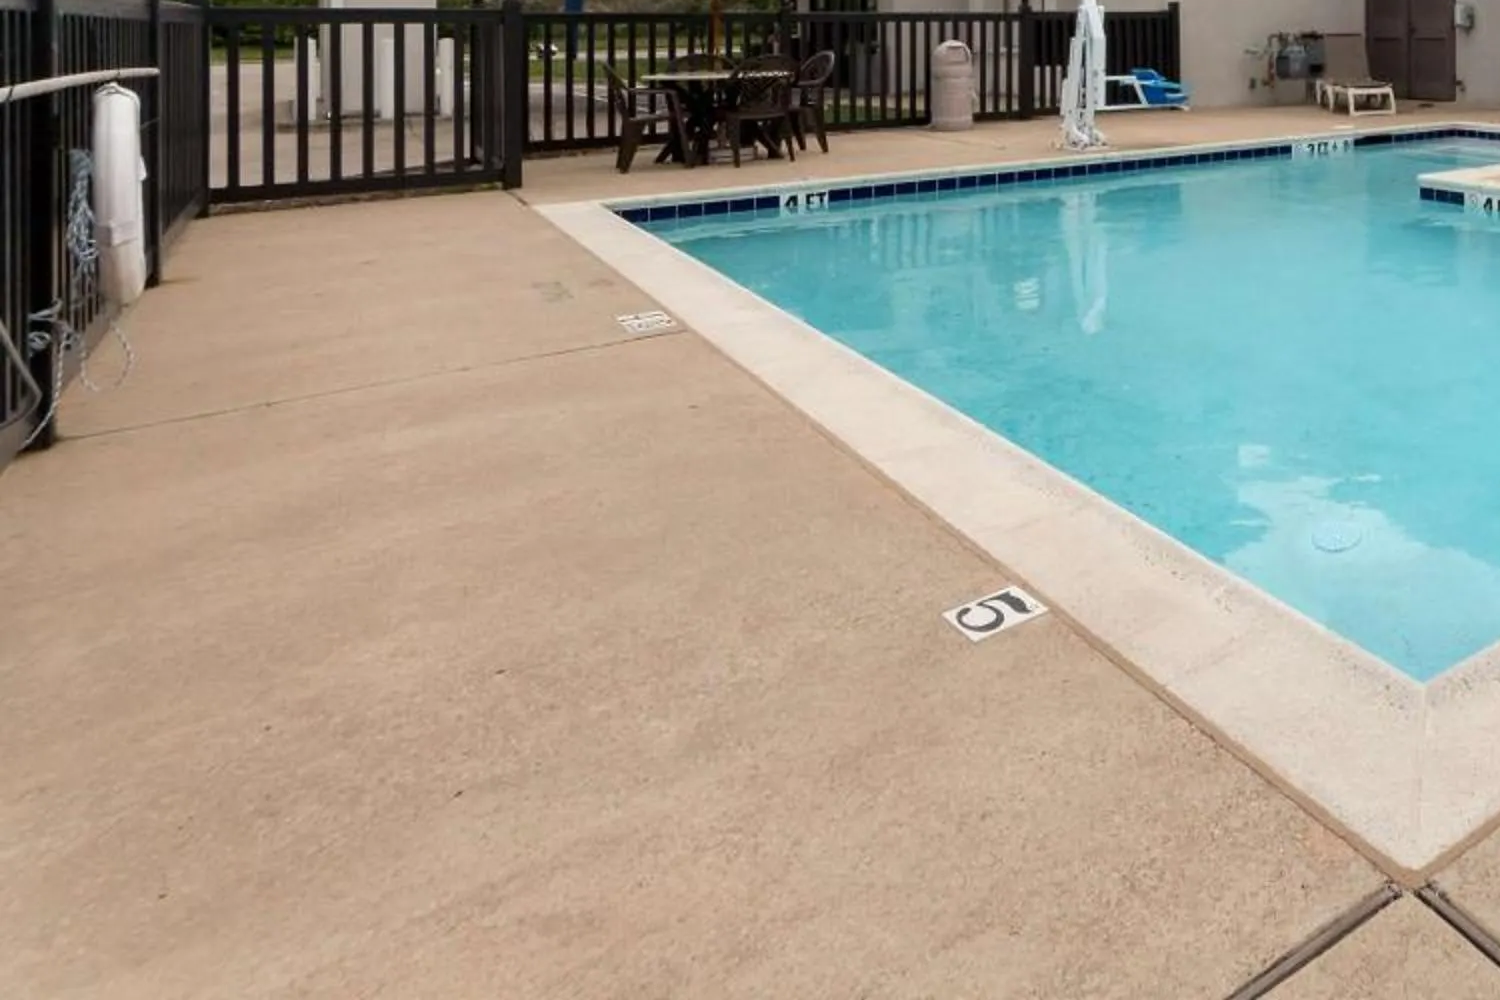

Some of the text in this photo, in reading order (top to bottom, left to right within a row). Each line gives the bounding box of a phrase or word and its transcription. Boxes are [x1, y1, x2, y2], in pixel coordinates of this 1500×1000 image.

[784, 191, 827, 208] 4 FT
[1483, 197, 1493, 212] 4
[955, 590, 1034, 632] 5
